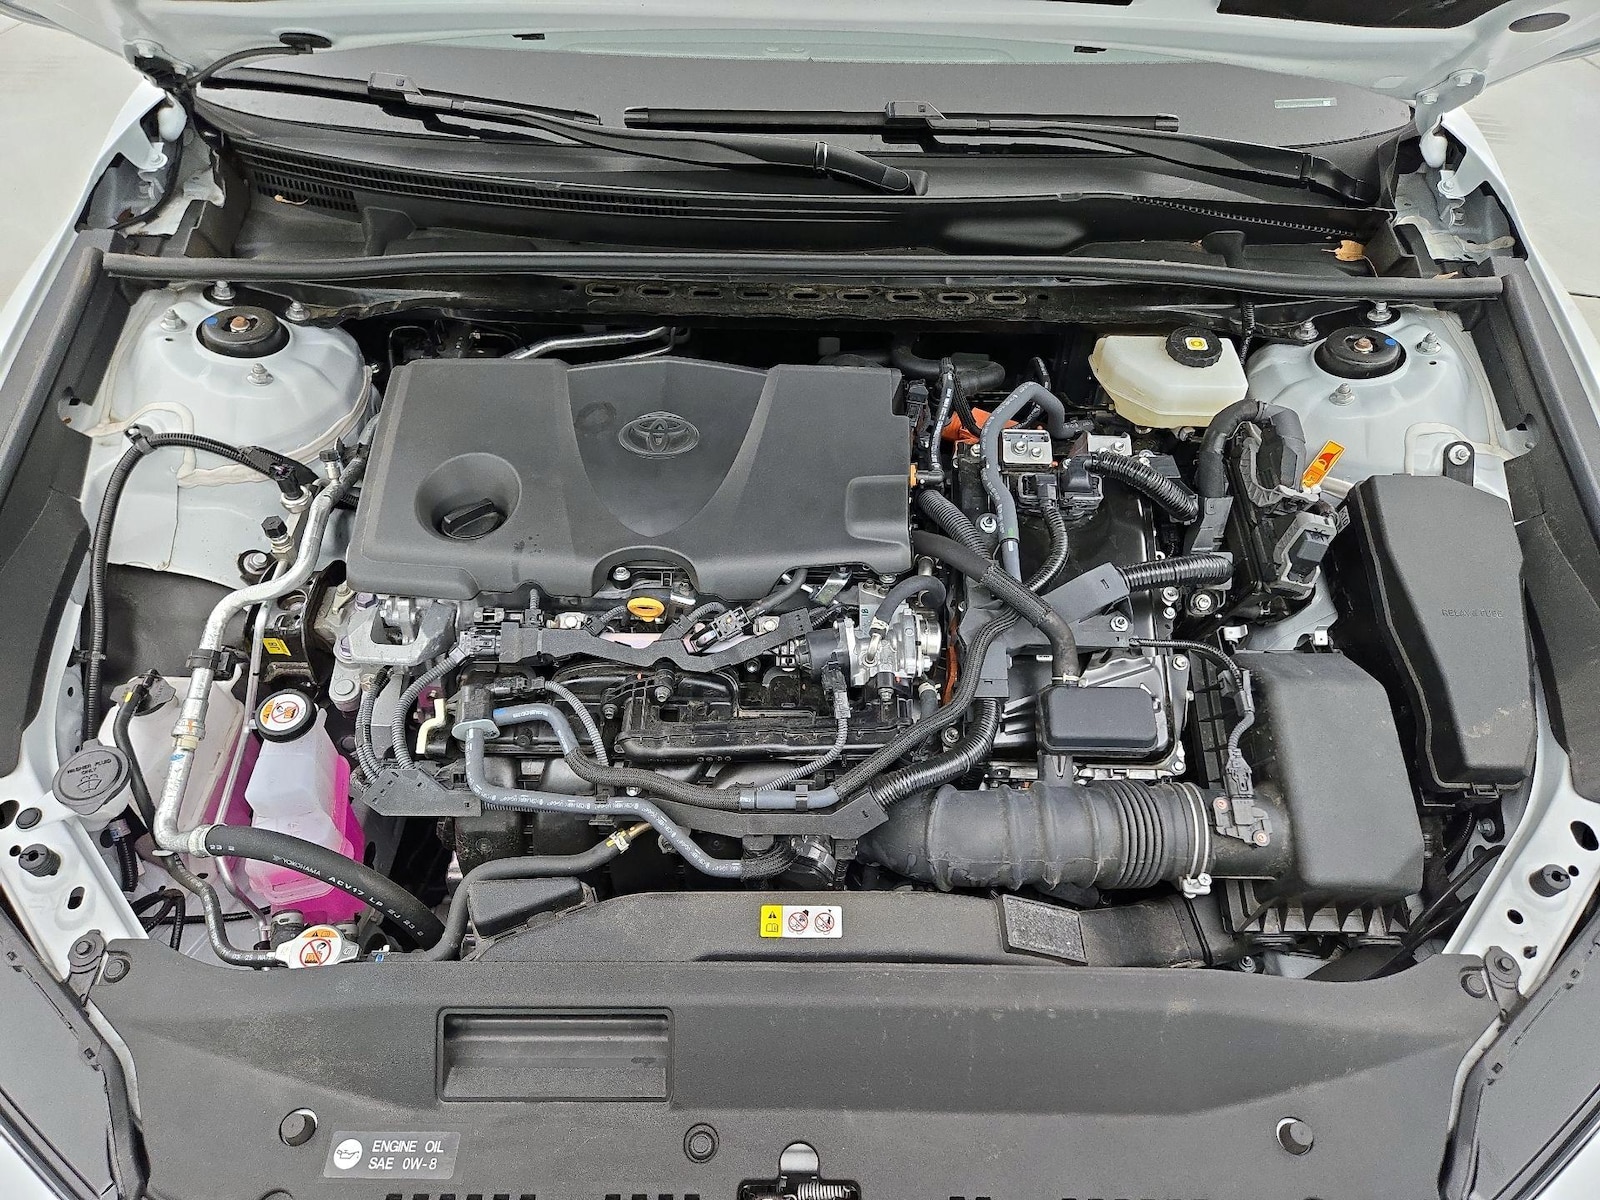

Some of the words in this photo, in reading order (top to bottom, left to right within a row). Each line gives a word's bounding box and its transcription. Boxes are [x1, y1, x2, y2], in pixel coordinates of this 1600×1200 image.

[282, 857, 321, 876] YOKOHAMA
[328, 876, 365, 896] ACV17
[372, 1140, 418, 1153] ENGINE
[424, 1140, 444, 1153] OIL
[368, 1157, 394, 1170] SAE
[402, 1157, 438, 1170] 0W-8
